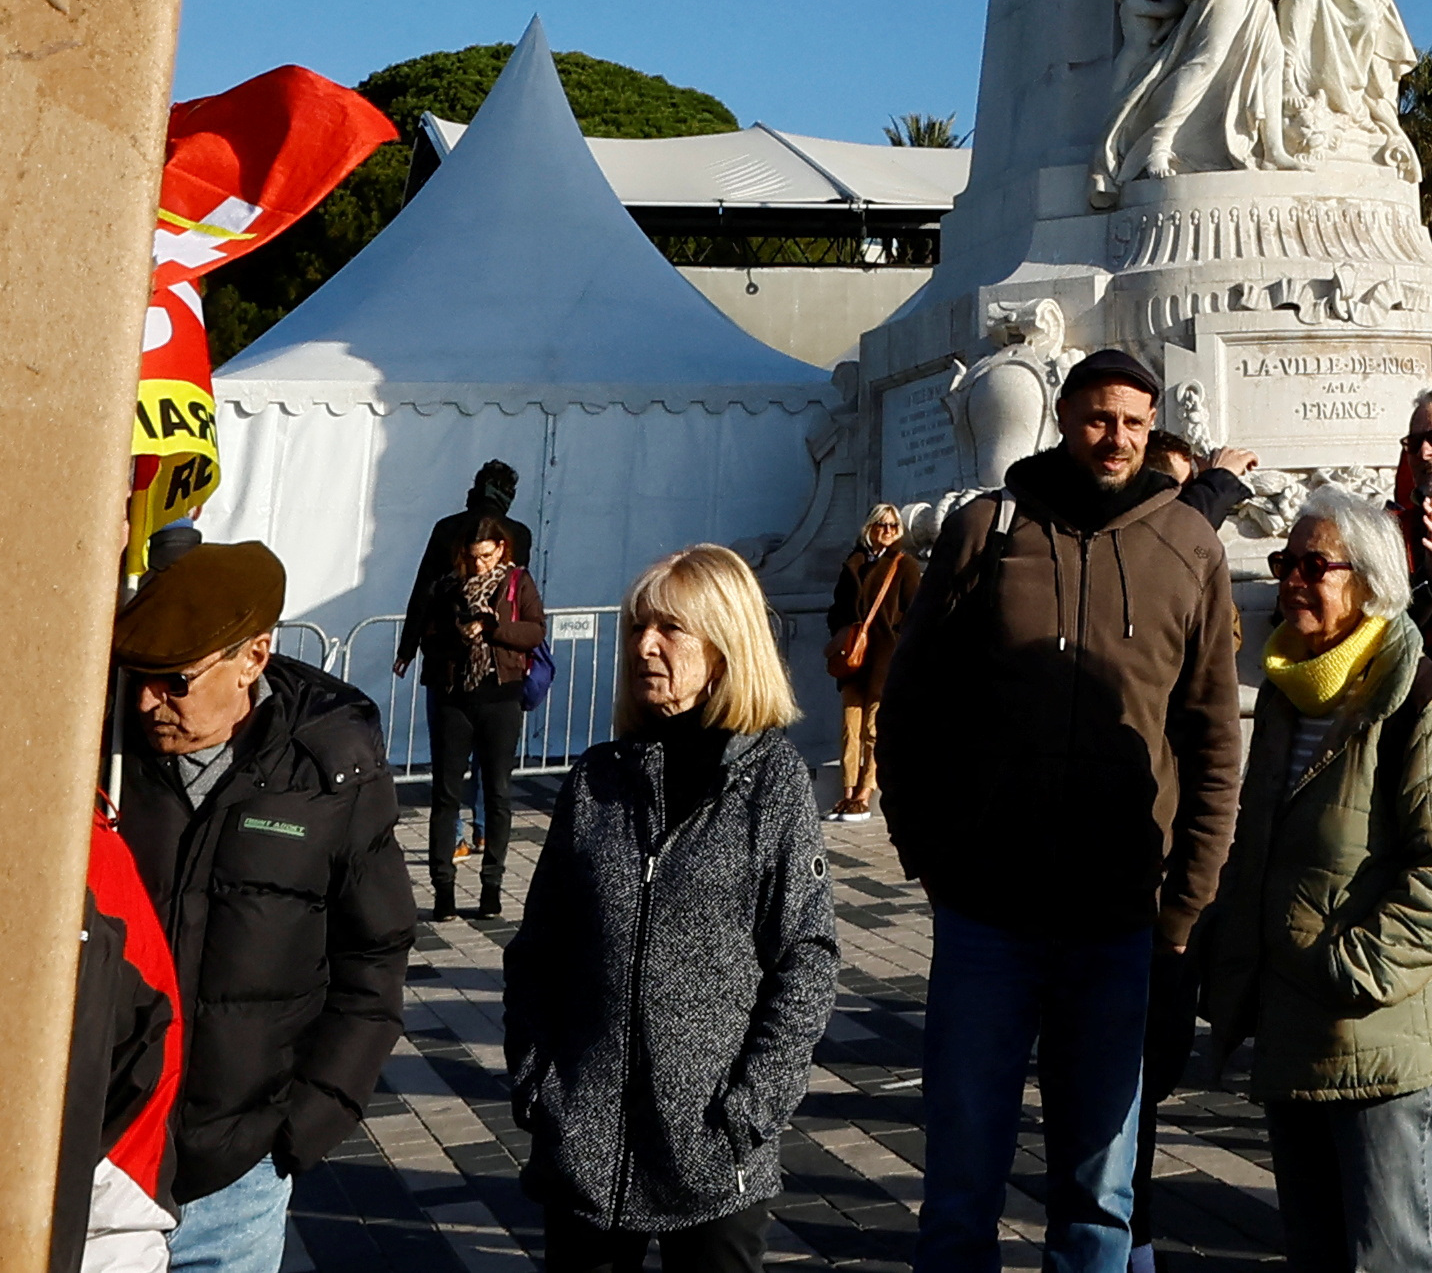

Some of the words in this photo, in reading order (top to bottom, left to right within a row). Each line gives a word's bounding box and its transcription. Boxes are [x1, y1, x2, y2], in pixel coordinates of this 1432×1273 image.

[1242, 359, 1272, 377] LA
[1279, 357, 1344, 375] VILLE
[1351, 357, 1377, 374] DE
[1382, 357, 1422, 375] NICE
[1302, 402, 1379, 420] FRANCE
